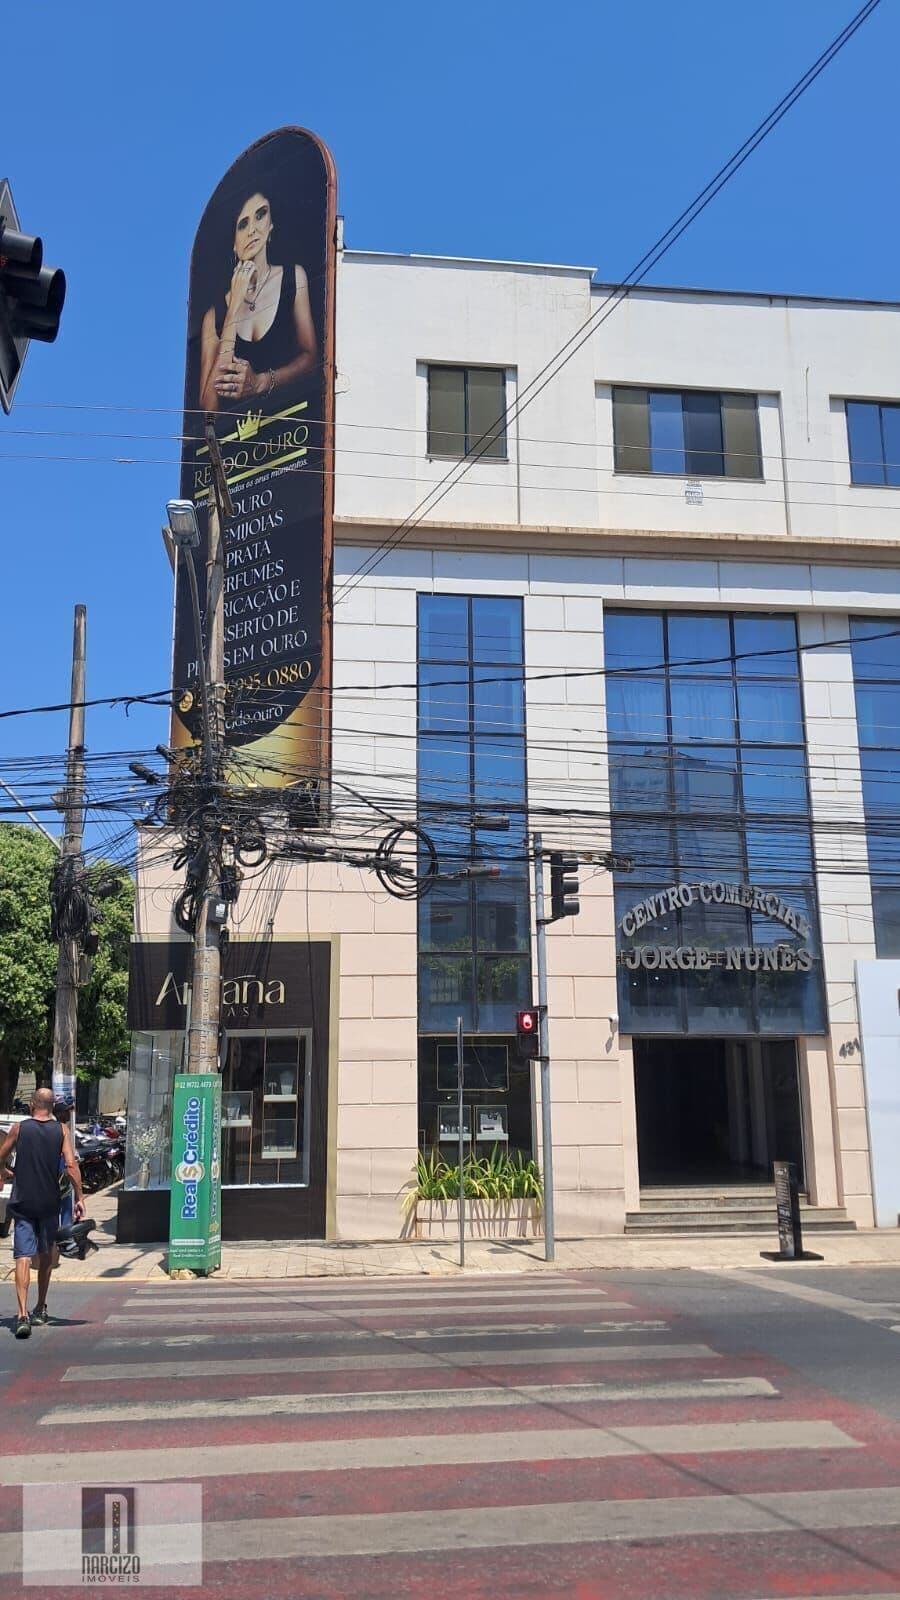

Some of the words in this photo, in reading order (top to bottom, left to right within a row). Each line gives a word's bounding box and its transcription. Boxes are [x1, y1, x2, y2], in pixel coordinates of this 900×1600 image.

[253, 425, 309, 461] OURO
[270, 458, 308, 480] momentos
[230, 489, 273, 518] OURO
[224, 509, 284, 545] EMIJOIAS
[226, 539, 271, 568] PRATA
[291, 579, 300, 597] E
[278, 605, 299, 627] DE
[234, 643, 255, 665] EM
[261, 629, 308, 657] OURO
[620, 883, 693, 937] CENTRO
[699, 880, 813, 941] COMERCIAL
[625, 946, 712, 971] JORGE
[725, 947, 813, 972] NUNES
[183, 1096, 200, 1165] Crédito
[181, 1179, 197, 1219] Real
